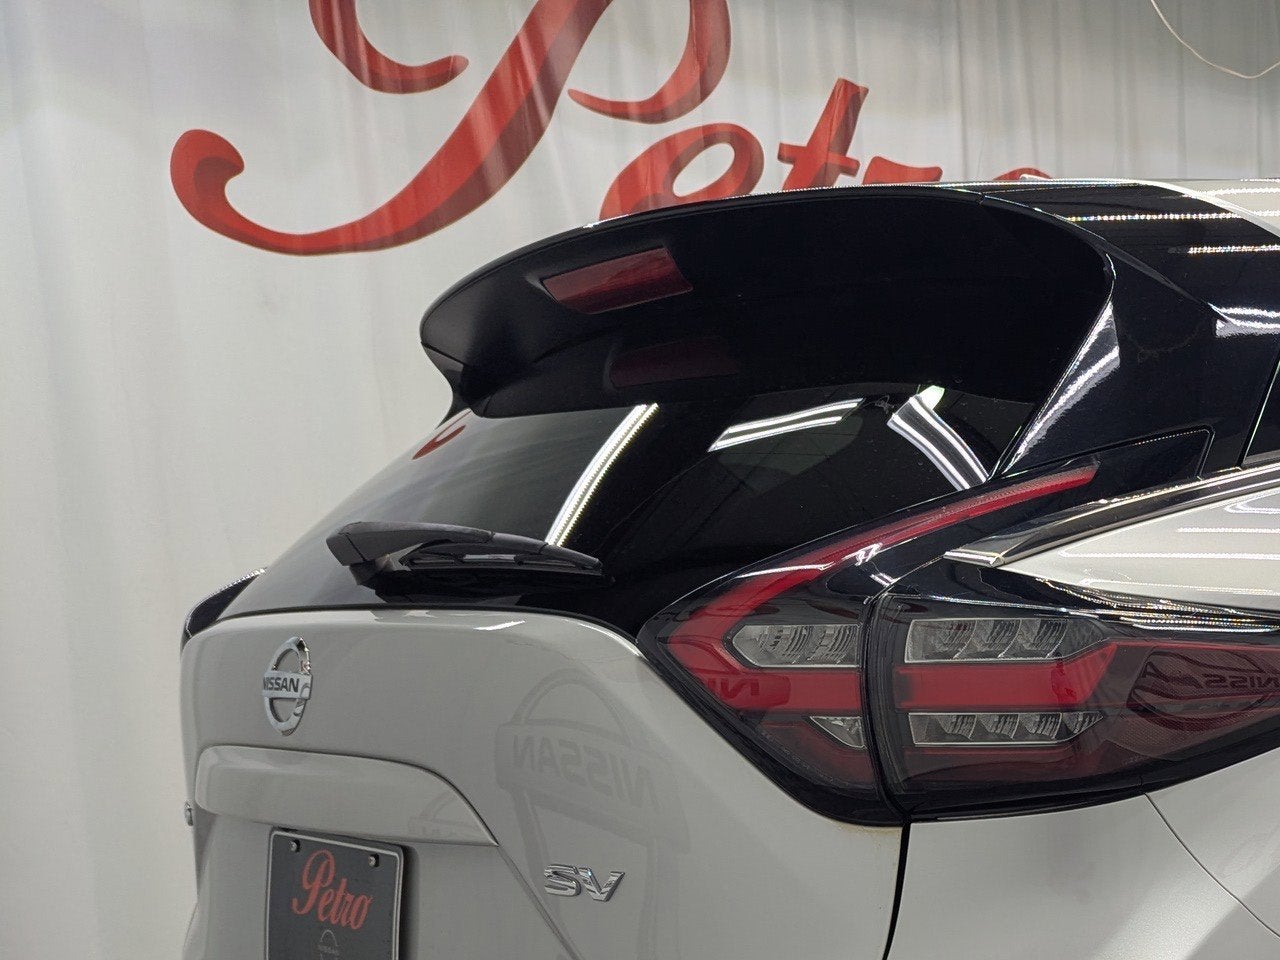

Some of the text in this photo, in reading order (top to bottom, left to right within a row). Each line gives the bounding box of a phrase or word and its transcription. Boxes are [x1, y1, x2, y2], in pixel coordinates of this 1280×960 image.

[262, 676, 300, 693] NISSAN
[291, 849, 373, 931] Petro
[543, 863, 626, 902] SV
